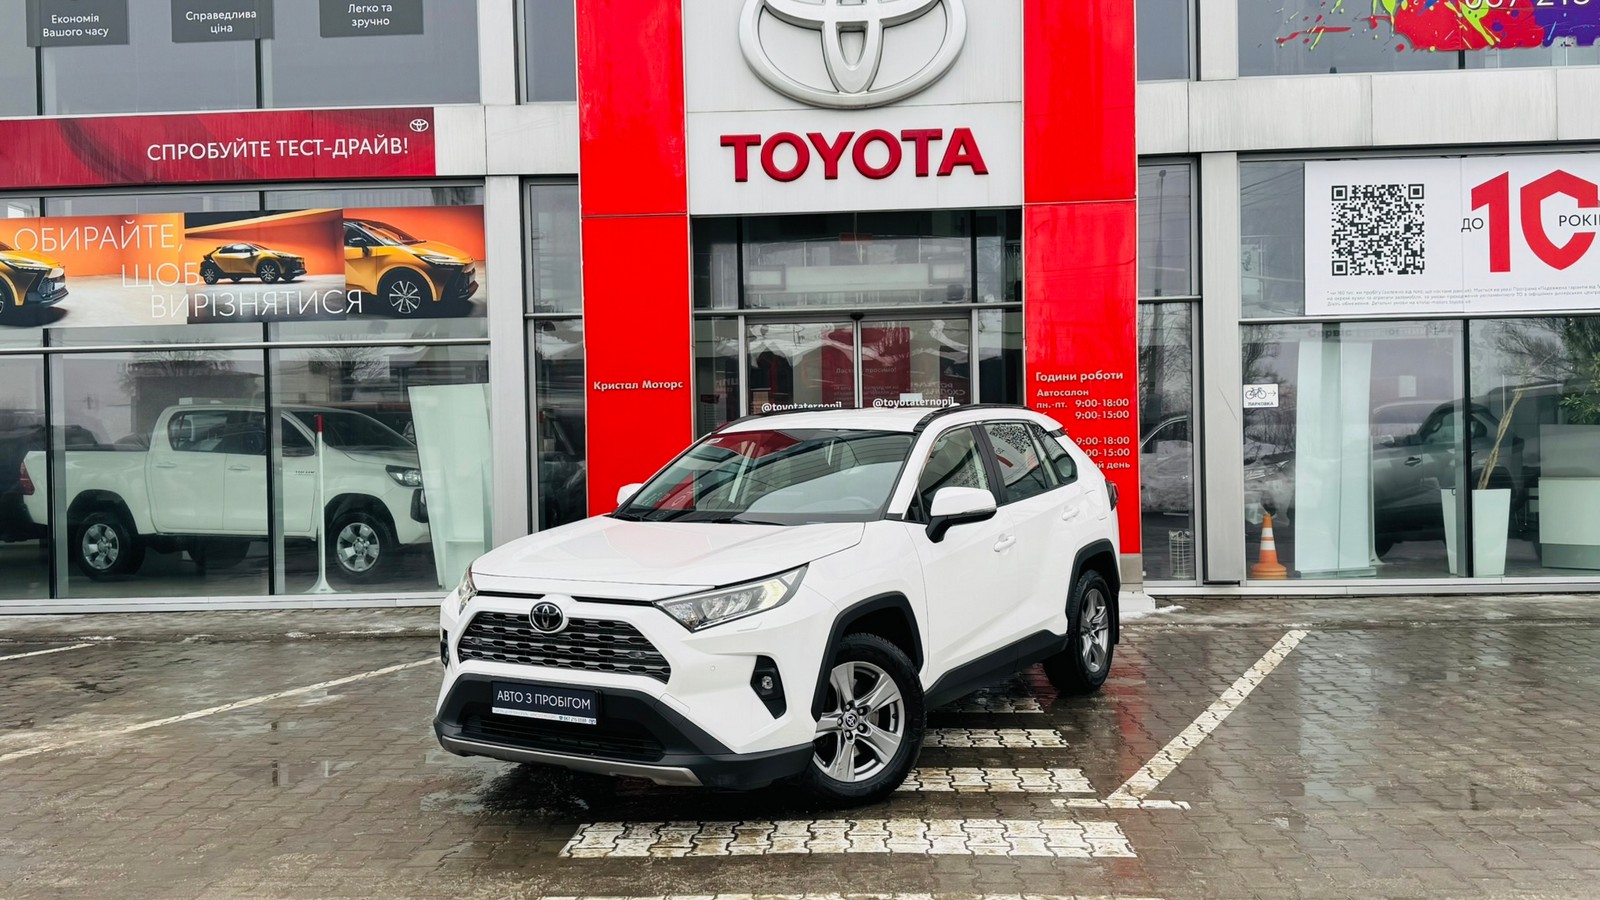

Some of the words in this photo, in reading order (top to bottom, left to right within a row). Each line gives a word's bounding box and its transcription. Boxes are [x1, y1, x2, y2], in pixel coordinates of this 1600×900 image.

[347, 3, 379, 13] Легко
[381, 4, 393, 12] та
[51, 13, 100, 24] Економія
[185, 10, 257, 22] Справедлива
[351, 17, 390, 28] зручно
[42, 28, 83, 38] Вашого
[85, 27, 109, 37] часу
[210, 23, 233, 34] ціна
[147, 137, 271, 161] СПРОБУЙТЕ
[276, 133, 409, 159] ТЕСТ-ДРАЙВ!
[720, 127, 989, 183] TOYOTA
[1461, 217, 1484, 233] ДО
[1558, 214, 1600, 227] РОКІ
[14, 219, 183, 252] ОБИРАЙТЕ,
[121, 262, 200, 290] ЩОБ
[151, 289, 363, 319] ВИРІЗНЯТИСЯ
[1035, 372, 1077, 382] Години
[1080, 370, 1124, 383] роботи
[593, 381, 639, 392] Кристал
[642, 380, 683, 390] Моторс
[1036, 389, 1089, 397] Автосалон
[1075, 399, 1129, 407] 9:00-18:00
[1075, 411, 1129, 419] 9:00-15:00
[1076, 437, 1130, 445] 9:00-18:00
[1106, 462, 1131, 470] день
[497, 690, 523, 702] АВТО
[535, 694, 591, 710] ПРОБІГОМ
